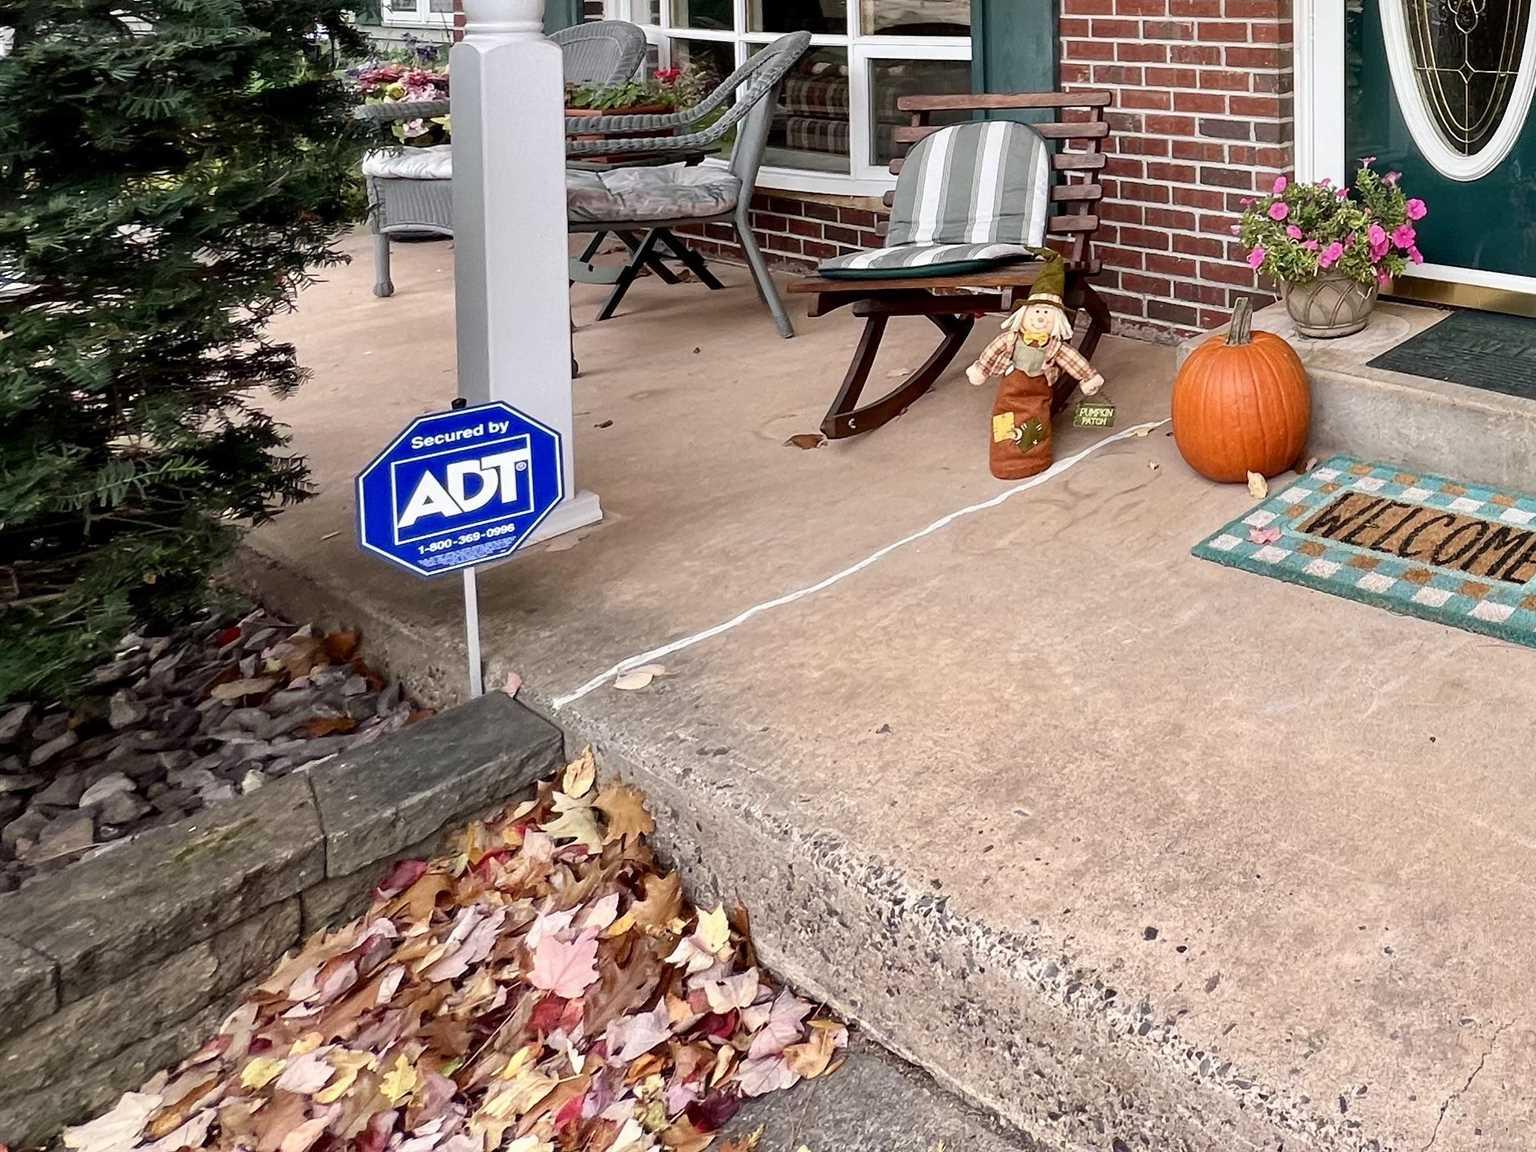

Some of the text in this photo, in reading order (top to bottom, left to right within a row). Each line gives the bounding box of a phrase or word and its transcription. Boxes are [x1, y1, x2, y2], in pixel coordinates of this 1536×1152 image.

[1080, 408, 1114, 417] PUMPKIN
[1081, 417, 1107, 426] PATCH
[411, 421, 510, 449] Secured by
[398, 447, 530, 529] ADT
